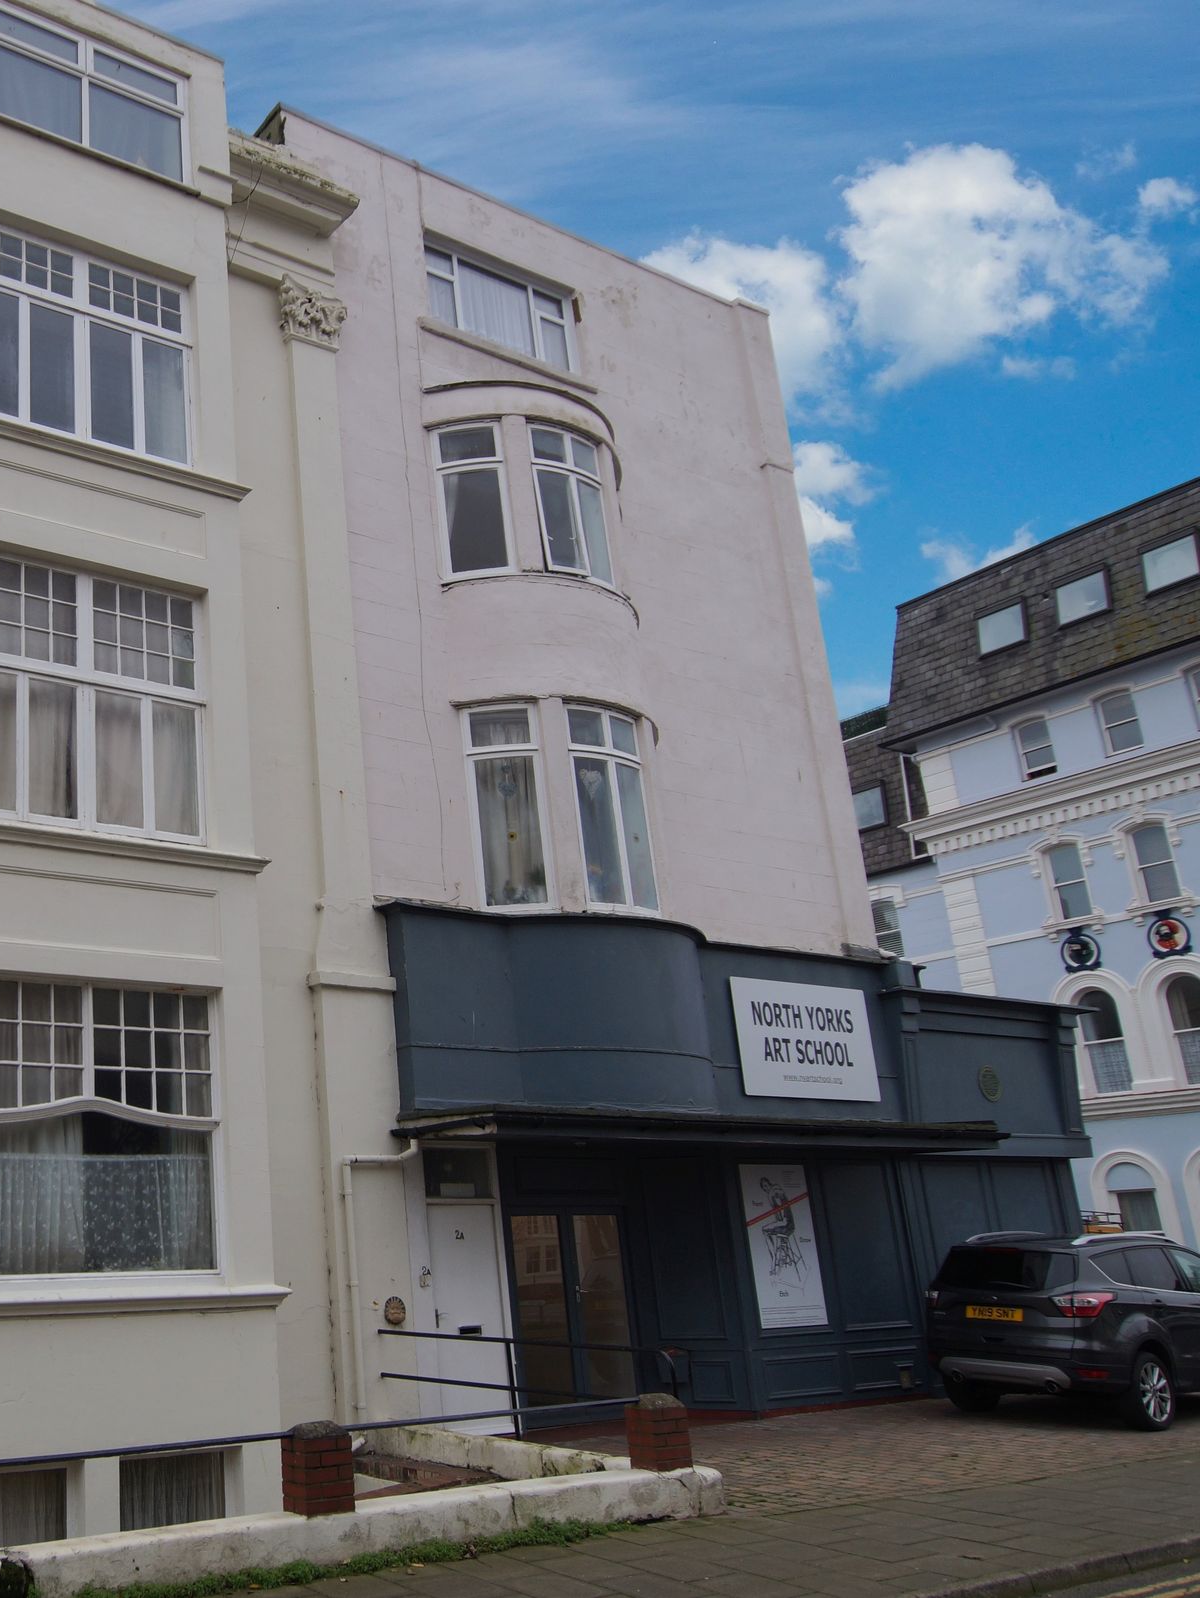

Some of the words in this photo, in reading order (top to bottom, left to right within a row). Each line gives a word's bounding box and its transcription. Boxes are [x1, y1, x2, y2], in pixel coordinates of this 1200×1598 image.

[751, 1001, 804, 1029] NORTH
[805, 1005, 854, 1034] YORKS
[764, 1037, 791, 1063] ART
[795, 1039, 854, 1067] SCHOOL
[455, 1229, 464, 1240] 2A
[421, 1265, 431, 1276] 2A
[995, 1308, 1016, 1319] SNT
